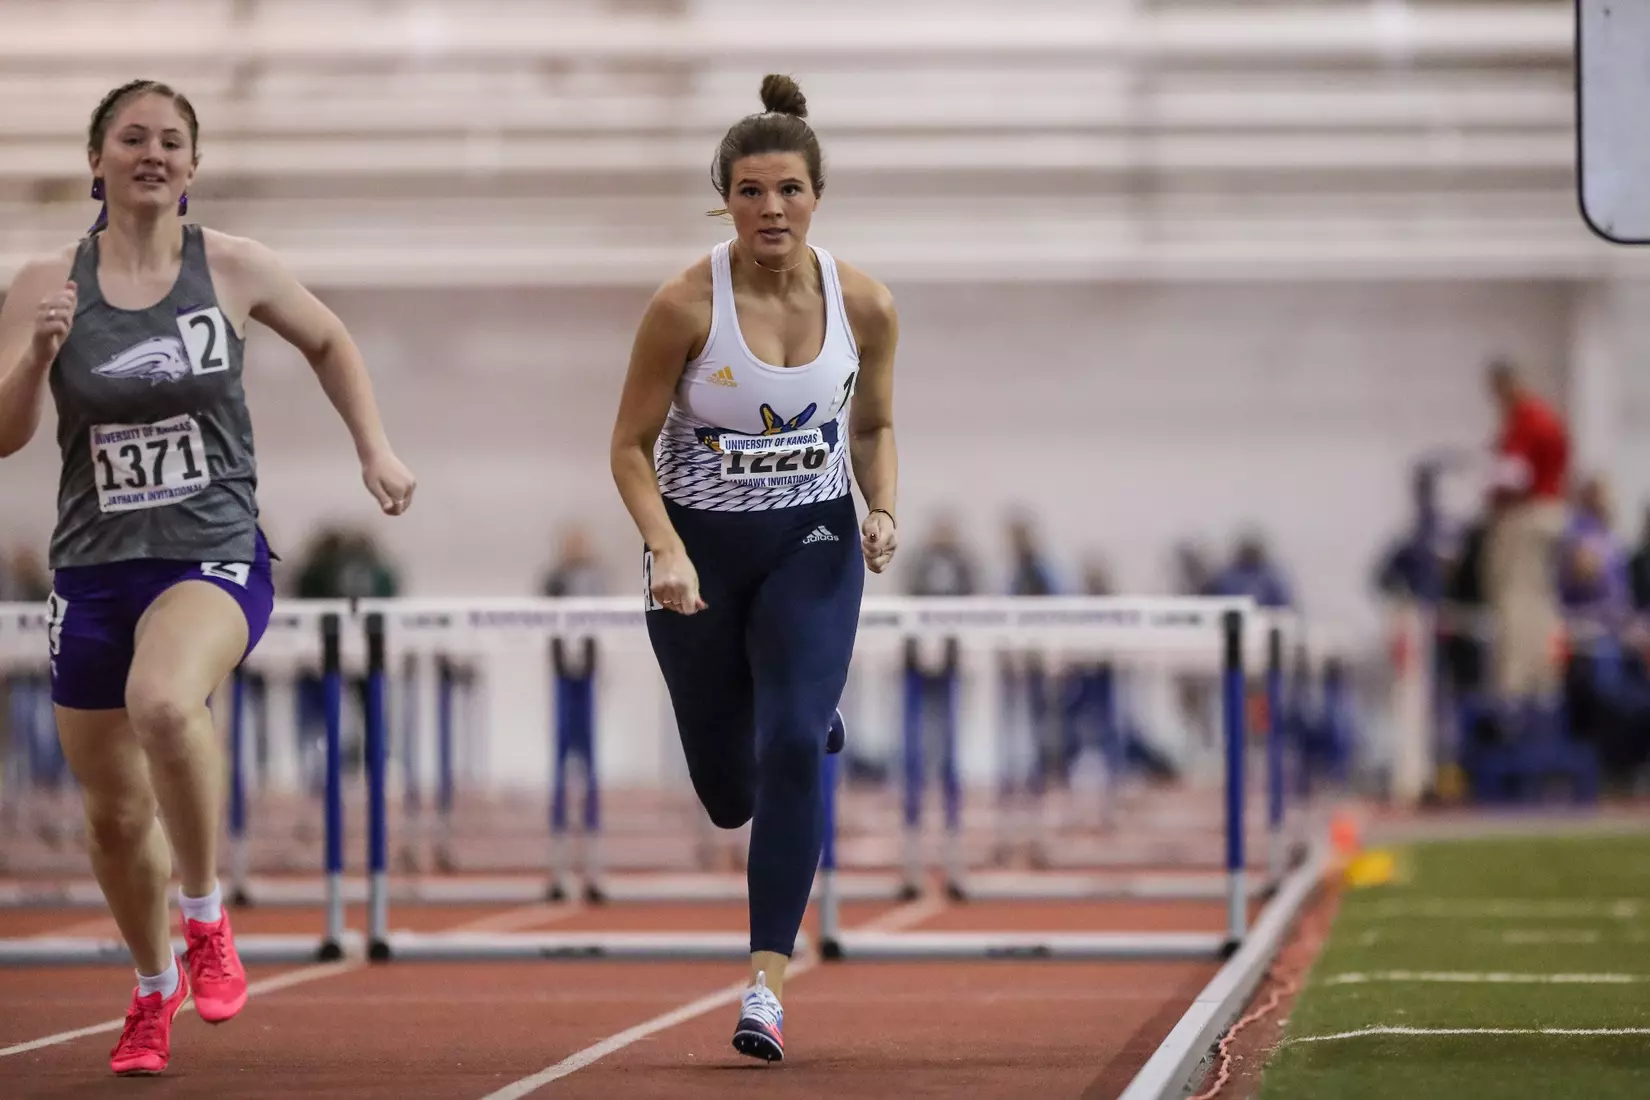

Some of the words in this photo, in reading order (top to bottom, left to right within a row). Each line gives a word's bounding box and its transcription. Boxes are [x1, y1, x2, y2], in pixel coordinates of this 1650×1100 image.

[187, 314, 223, 369] 2
[142, 426, 153, 437] OF
[725, 438, 773, 450] UNIVERSITY
[774, 437, 786, 447] OF
[786, 433, 818, 446] KANSAS
[97, 434, 203, 491] 1371
[767, 473, 818, 487] INVITATIONAL
[147, 483, 203, 501] INVITATIONAL
